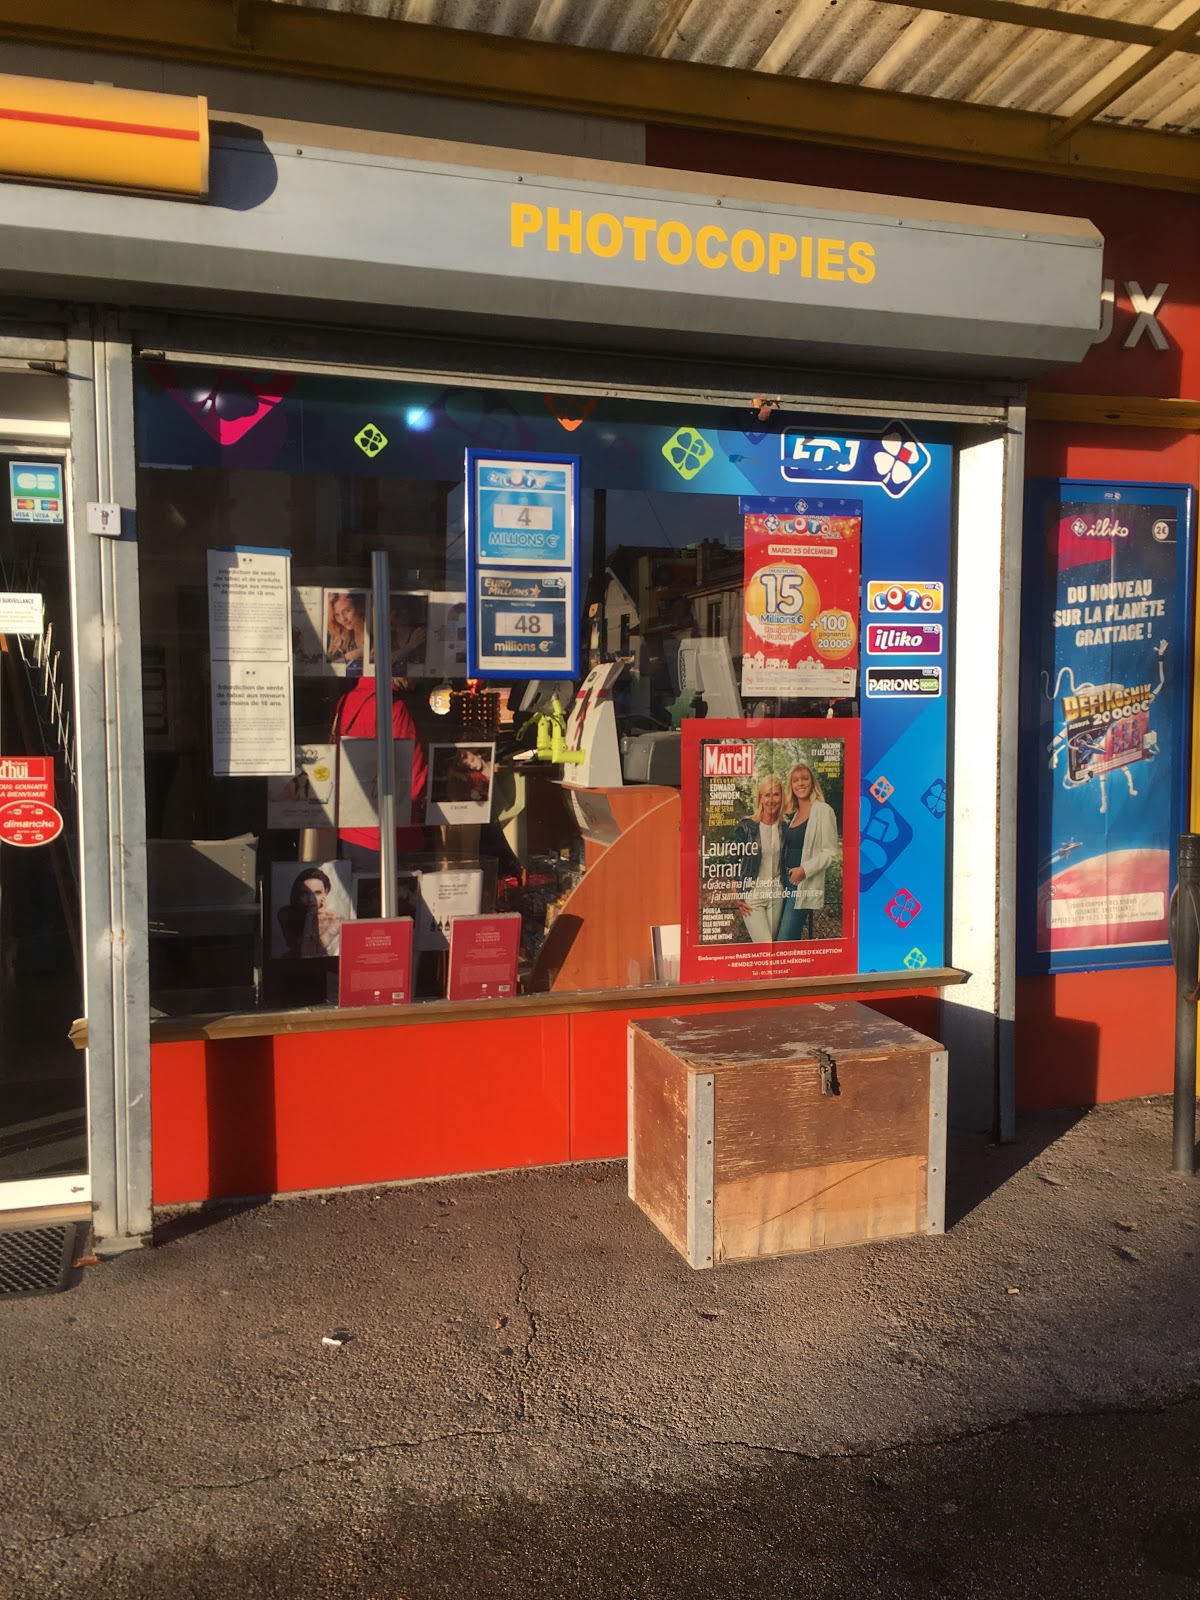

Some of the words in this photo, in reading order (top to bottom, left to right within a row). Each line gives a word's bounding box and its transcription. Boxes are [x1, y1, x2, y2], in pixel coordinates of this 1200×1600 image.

[511, 202, 876, 284] PHOTOCOPIES
[517, 507, 532, 527] 4
[784, 517, 830, 534] LOTO
[1086, 517, 1129, 537] illiko
[1156, 525, 1168, 535] 2€
[488, 532, 544, 547] MILLIONS
[803, 547, 835, 556] DÉCEMBRE
[484, 577, 512, 589] EURO
[488, 585, 530, 597] MILLIONS
[760, 574, 804, 616] 15
[875, 586, 933, 611] LOTO
[1067, 585, 1088, 604] DU
[1090, 579, 1153, 602] NOUVEAU
[760, 615, 796, 625] Millions
[1053, 608, 1081, 628] SUR
[1084, 606, 1105, 625] LA
[1105, 598, 1166, 622] PLANÈTE
[514, 615, 541, 634] 48
[819, 632, 847, 640] gagnants
[875, 629, 923, 650] illiko
[1075, 626, 1145, 647] GRATTAGE
[494, 641, 536, 652] millions
[869, 679, 920, 691] PARIONS
[920, 681, 938, 689] sport
[1105, 684, 1153, 711] KOSMIK
[705, 746, 752, 775] MATCH
[710, 783, 736, 792] EDWARD
[710, 792, 740, 800] SNOWDEN
[3, 819, 55, 828] dimanche
[702, 835, 759, 857] Laurence
[702, 857, 742, 878] Ferrari
[707, 878, 726, 890] Grâce
[726, 879, 731, 889] à
[731, 881, 742, 889] ma
[742, 877, 756, 891] fille
[710, 890, 722, 903] j'ai
[722, 888, 752, 901] surmonté
[753, 888, 759, 899] le
[781, 887, 790, 899] de
[776, 948, 807, 957] CROISIÈRES
[808, 947, 842, 956] D'EXCEPTION
[787, 957, 811, 965] MÉKONG
